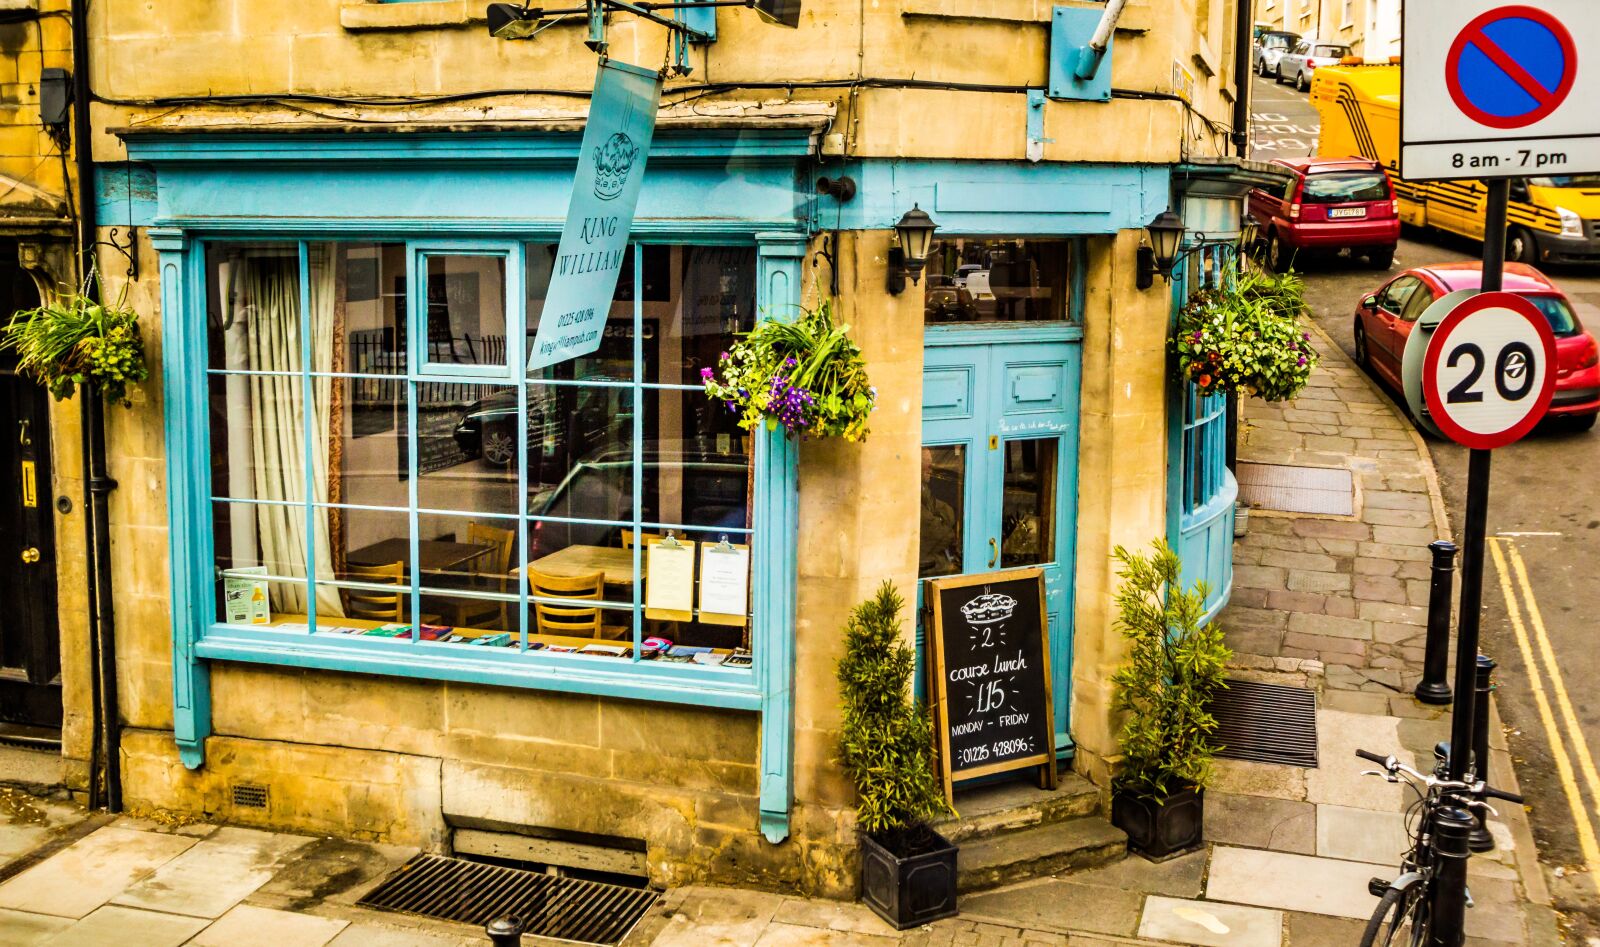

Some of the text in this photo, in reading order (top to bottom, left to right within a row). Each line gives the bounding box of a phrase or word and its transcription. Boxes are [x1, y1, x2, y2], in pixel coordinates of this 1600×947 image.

[1452, 153, 1464, 168] 8
[1469, 155, 1500, 168] am
[1518, 150, 1531, 167] 7
[1536, 152, 1567, 168] pm
[580, 216, 618, 244] KING
[558, 250, 622, 276] WILLIAM
[557, 312, 575, 328] 01225
[1446, 341, 1536, 404] 20
[981, 627, 995, 647] 2
[950, 662, 990, 682] course
[951, 720, 984, 736] MONDAY
[1000, 713, 1030, 728] FRIDAY
[963, 738, 1028, 763] 01225 428096
